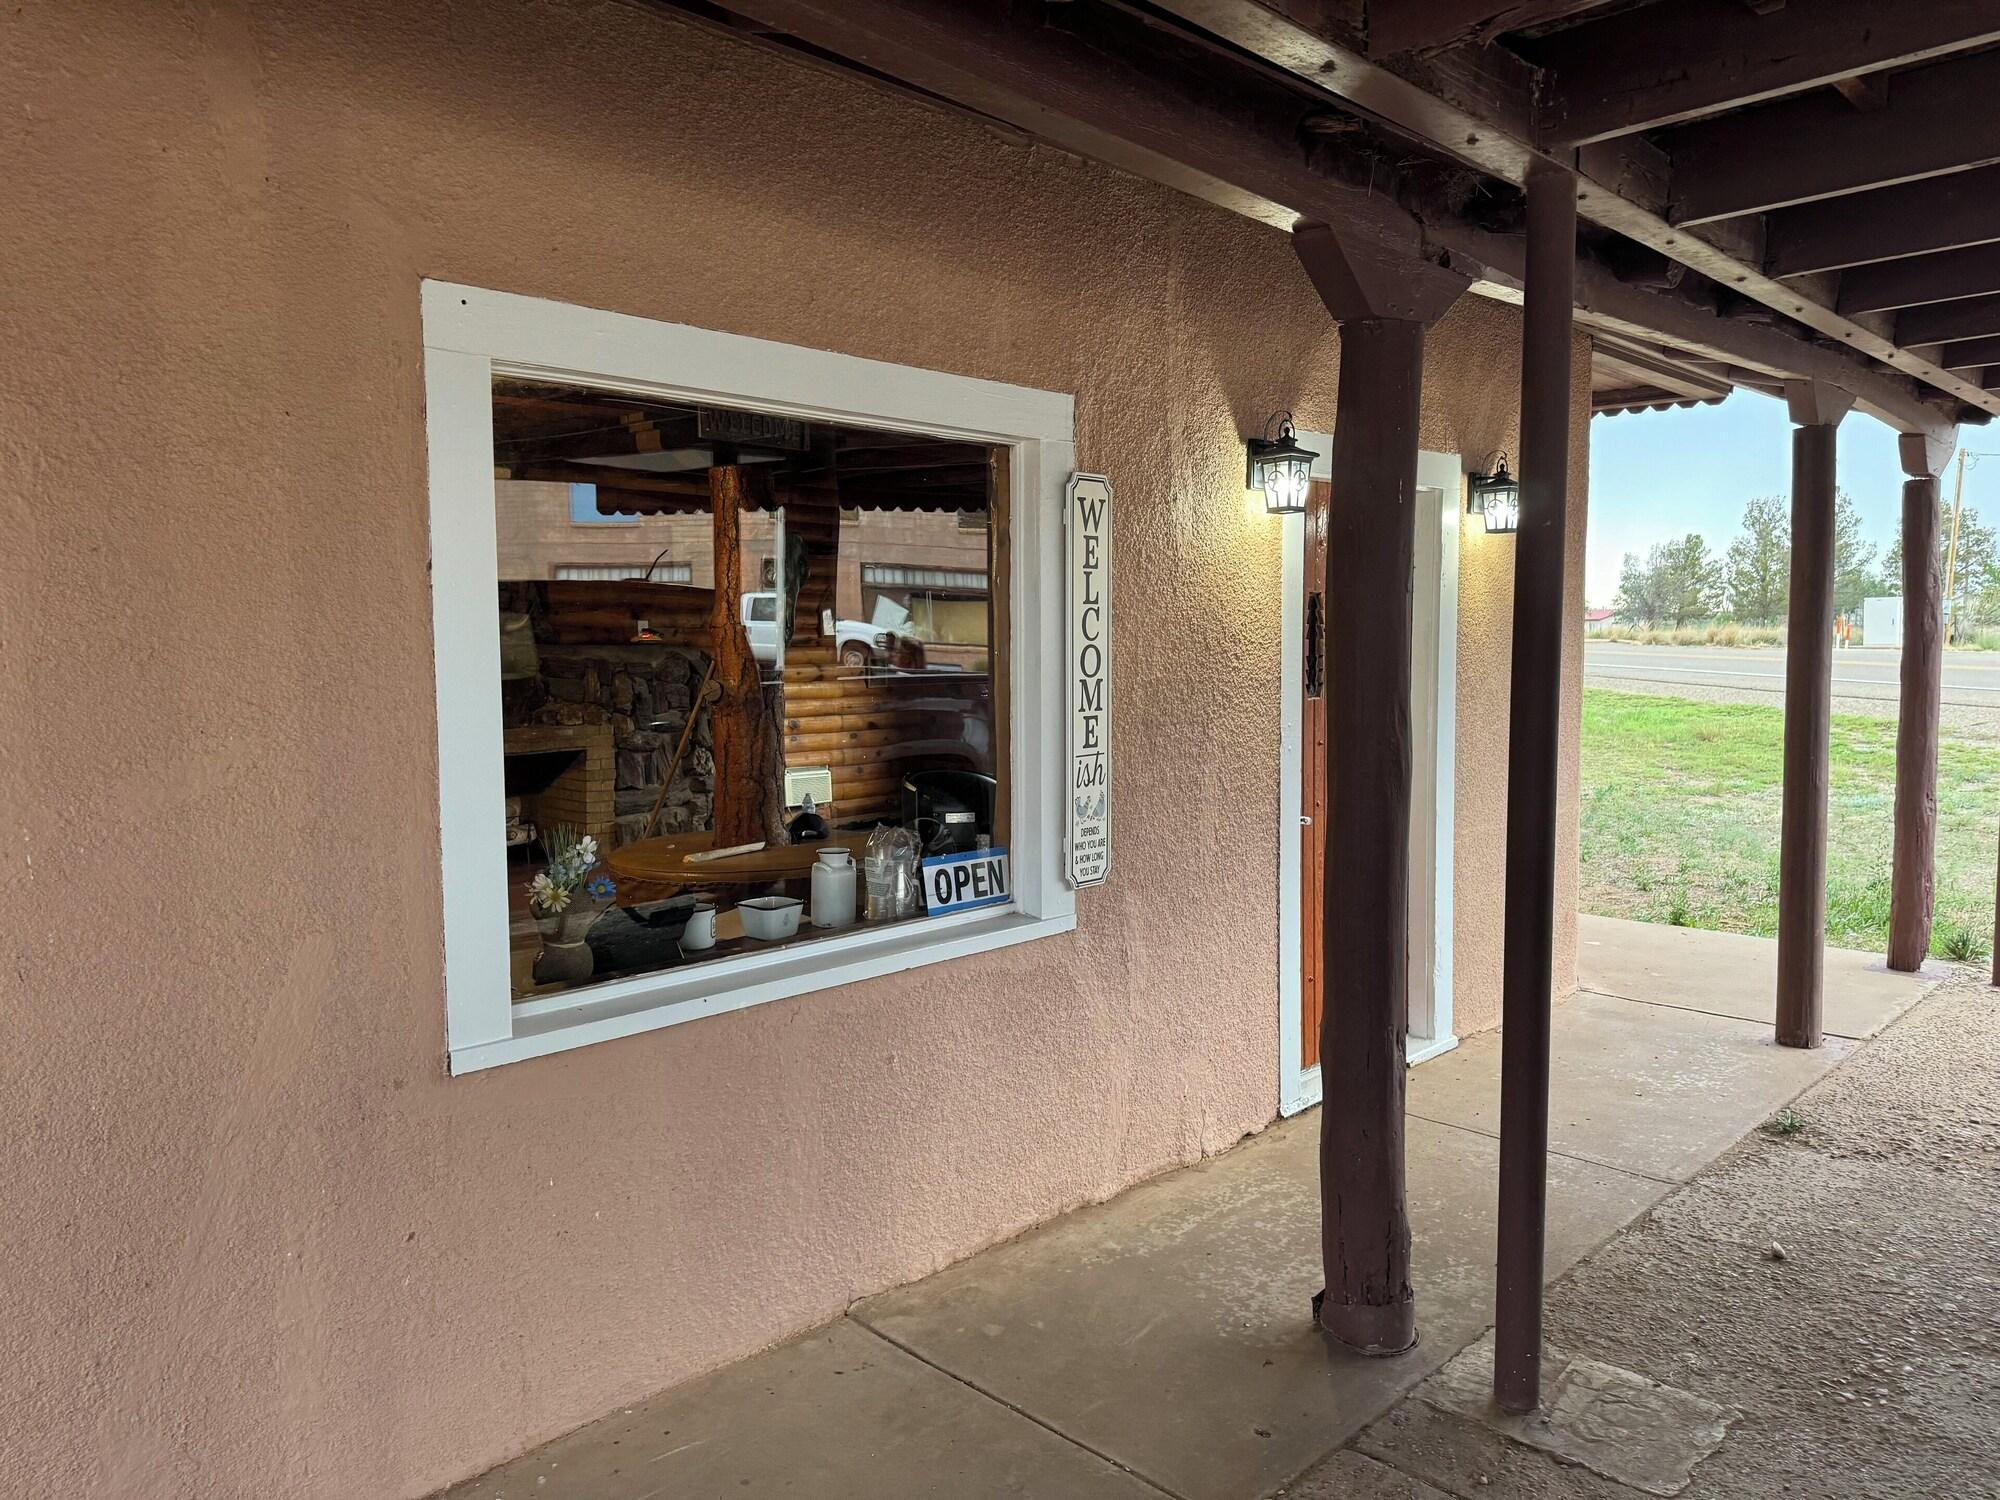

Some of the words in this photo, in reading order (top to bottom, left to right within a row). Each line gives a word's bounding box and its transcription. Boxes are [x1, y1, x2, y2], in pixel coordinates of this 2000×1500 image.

[1077, 496, 1106, 749] WELCOME
[1076, 750, 1106, 789] ish
[1080, 825, 1100, 837] DEPENDS
[1074, 841, 1087, 851] WHO
[1087, 839, 1097, 850] YOU
[1097, 837, 1106, 848] ARE
[1074, 855, 1079, 865] &
[1079, 853, 1091, 864] HOW
[1091, 850, 1104, 862] LONG
[1079, 866, 1090, 877] YOU
[1089, 864, 1100, 875] STAY
[934, 859, 1005, 905] OPEN
